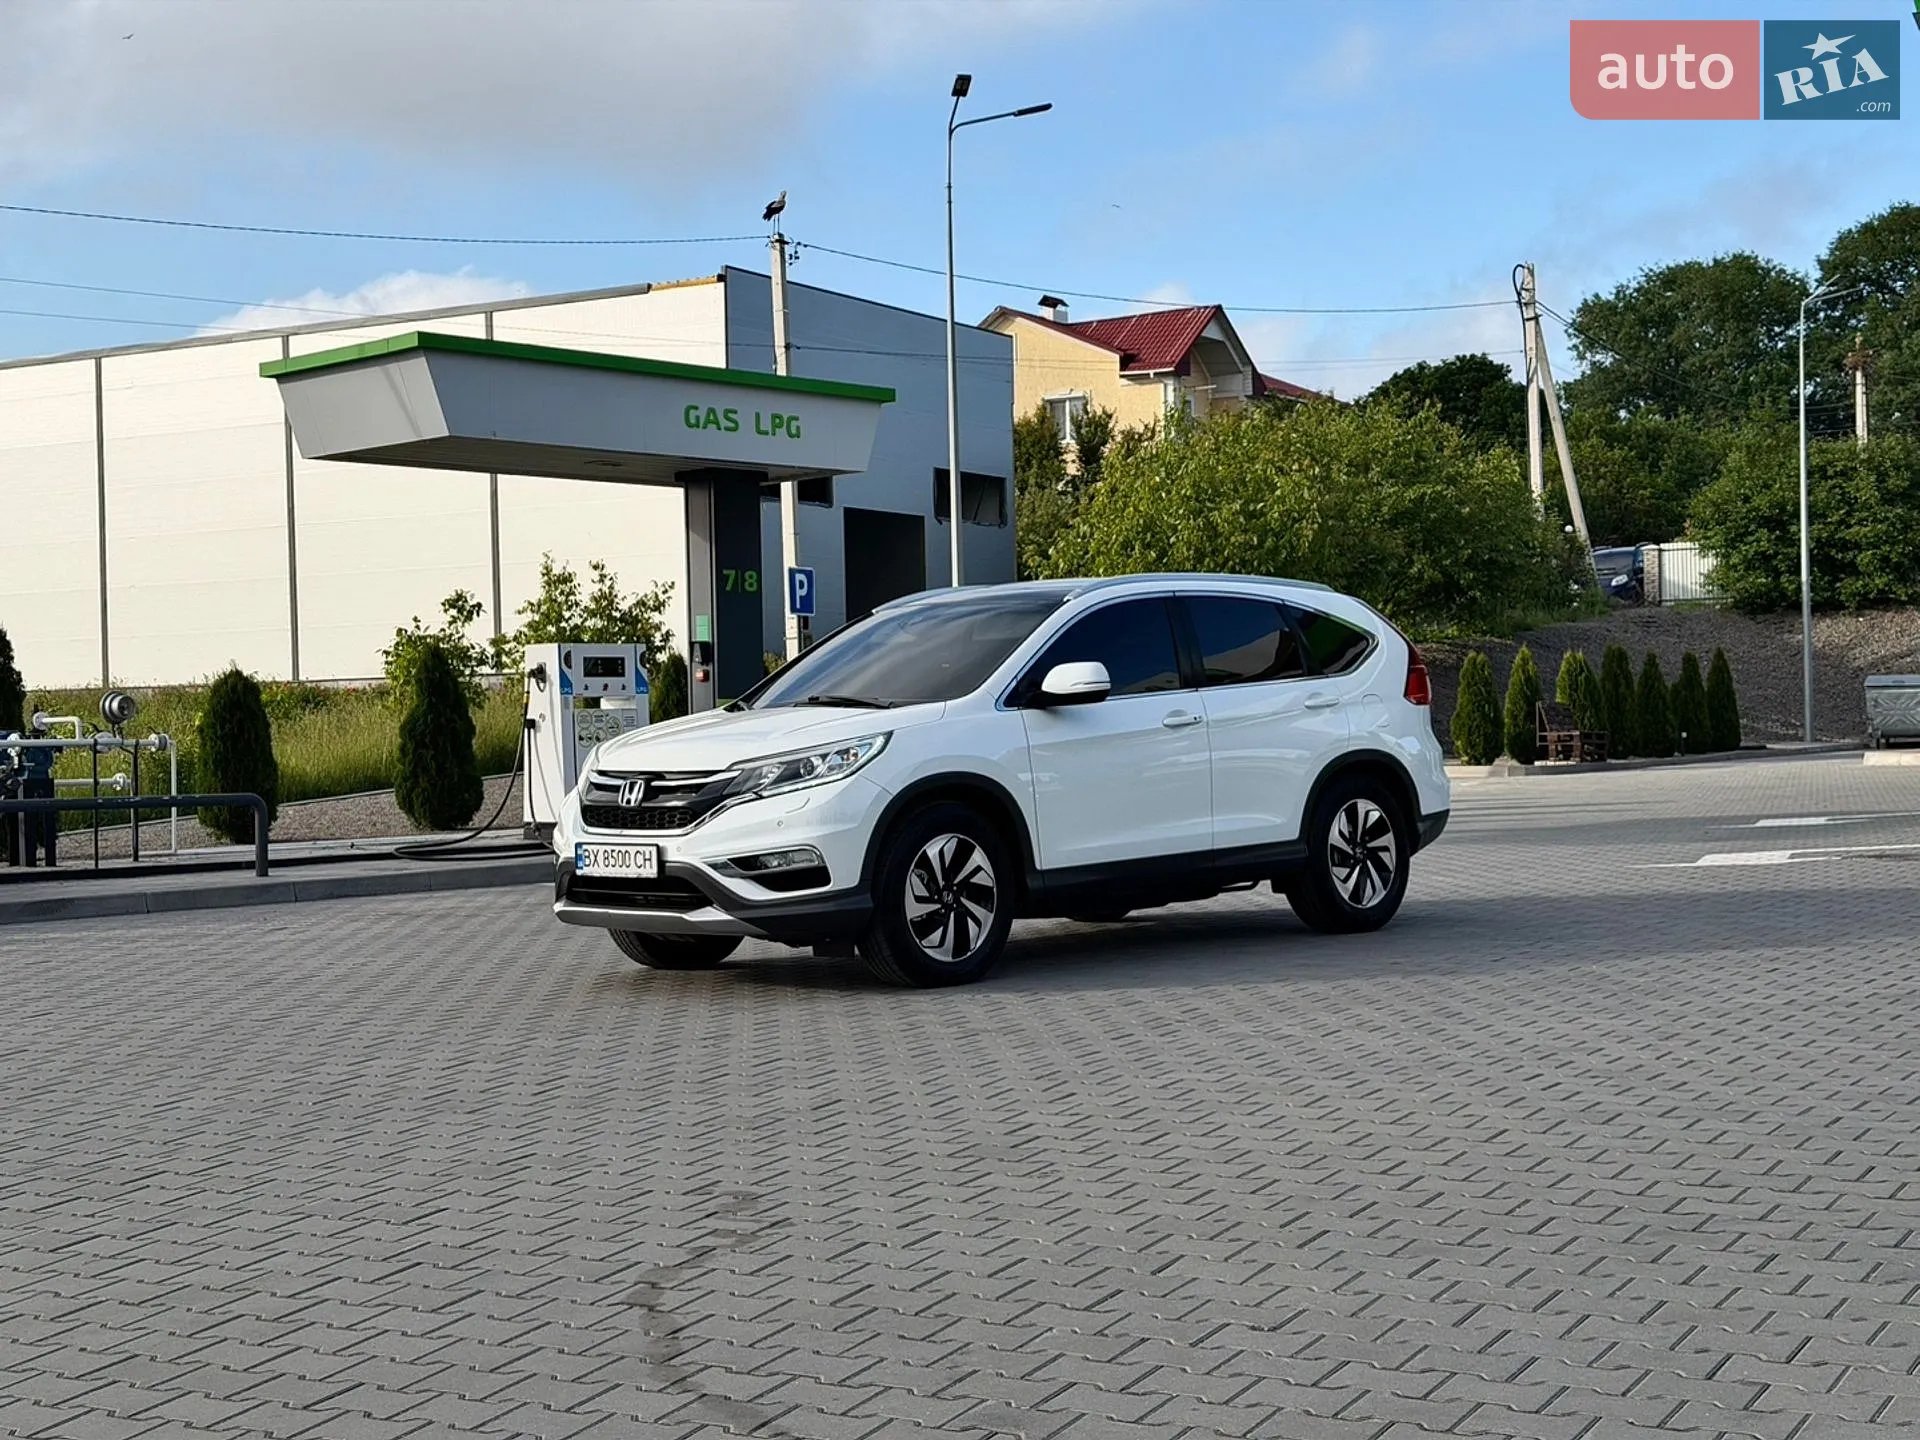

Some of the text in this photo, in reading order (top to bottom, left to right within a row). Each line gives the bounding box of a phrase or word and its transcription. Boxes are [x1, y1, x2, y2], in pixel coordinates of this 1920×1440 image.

[683, 404, 801, 439] GAS LPG
[794, 572, 808, 609] P
[582, 848, 600, 868] BX
[602, 849, 632, 869] 8500
[634, 849, 653, 870] CH
